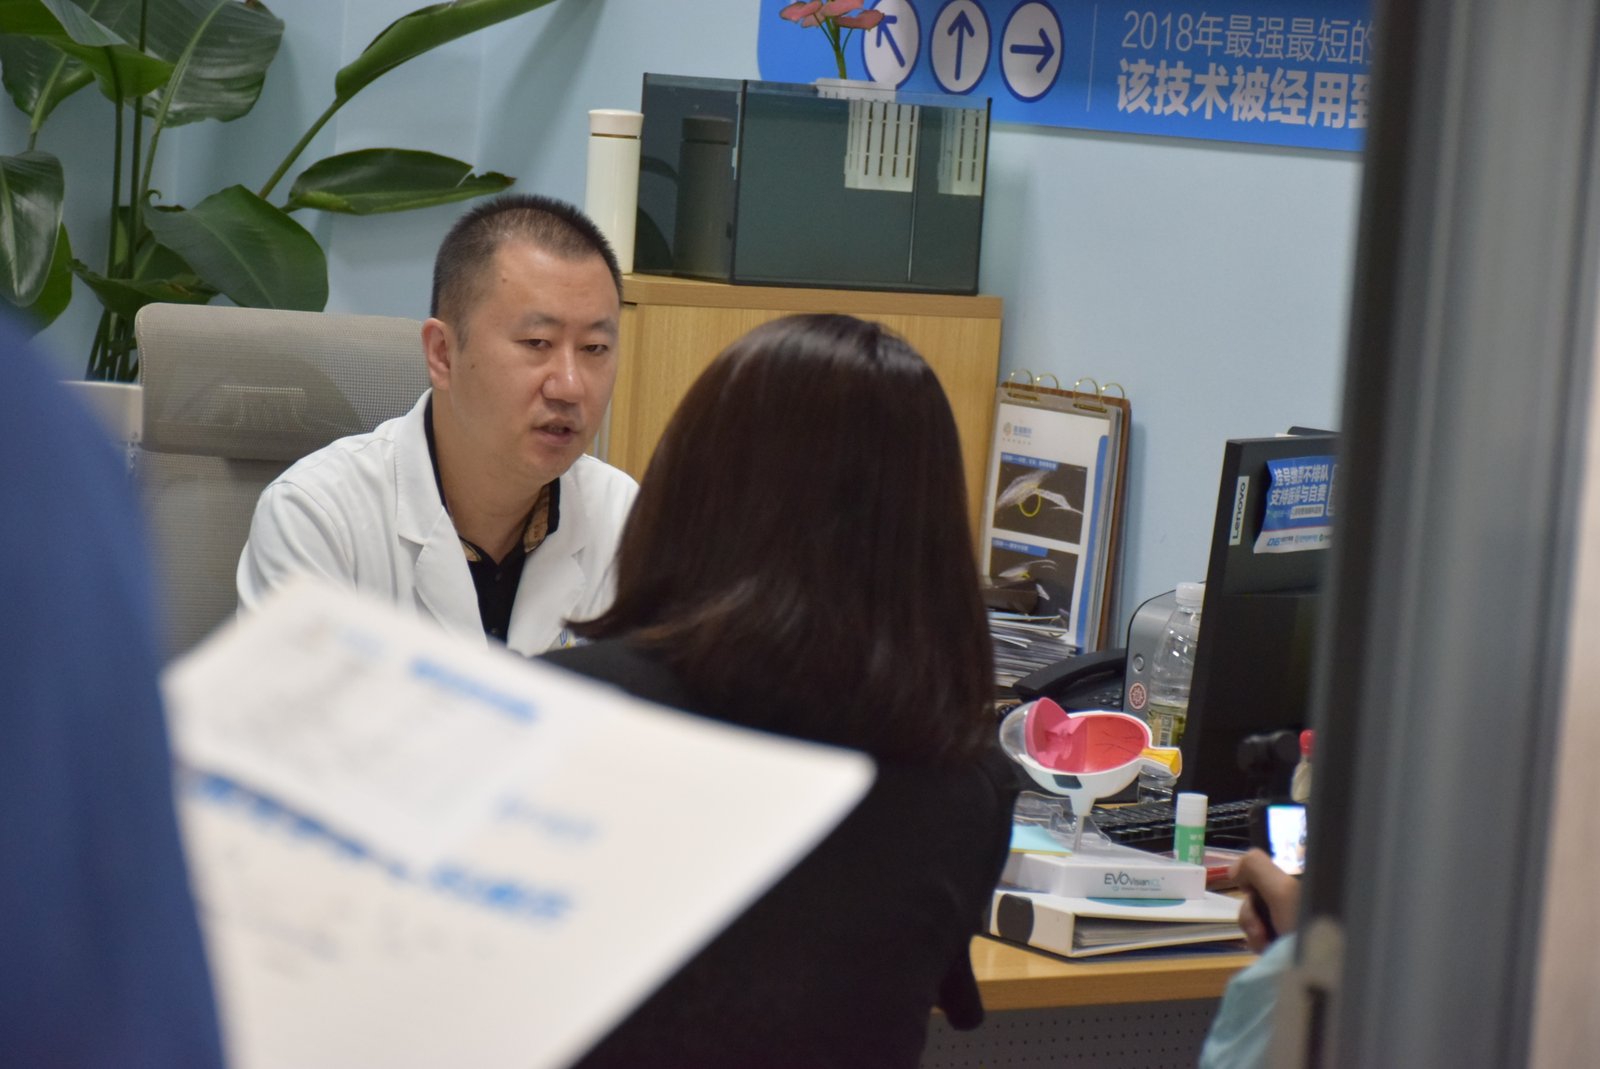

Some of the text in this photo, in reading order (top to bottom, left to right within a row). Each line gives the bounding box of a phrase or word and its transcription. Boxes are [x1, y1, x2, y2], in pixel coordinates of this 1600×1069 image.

[1121, 10, 1373, 65] 2018年最强最短的
[1232, 482, 1245, 539] Lenovo
